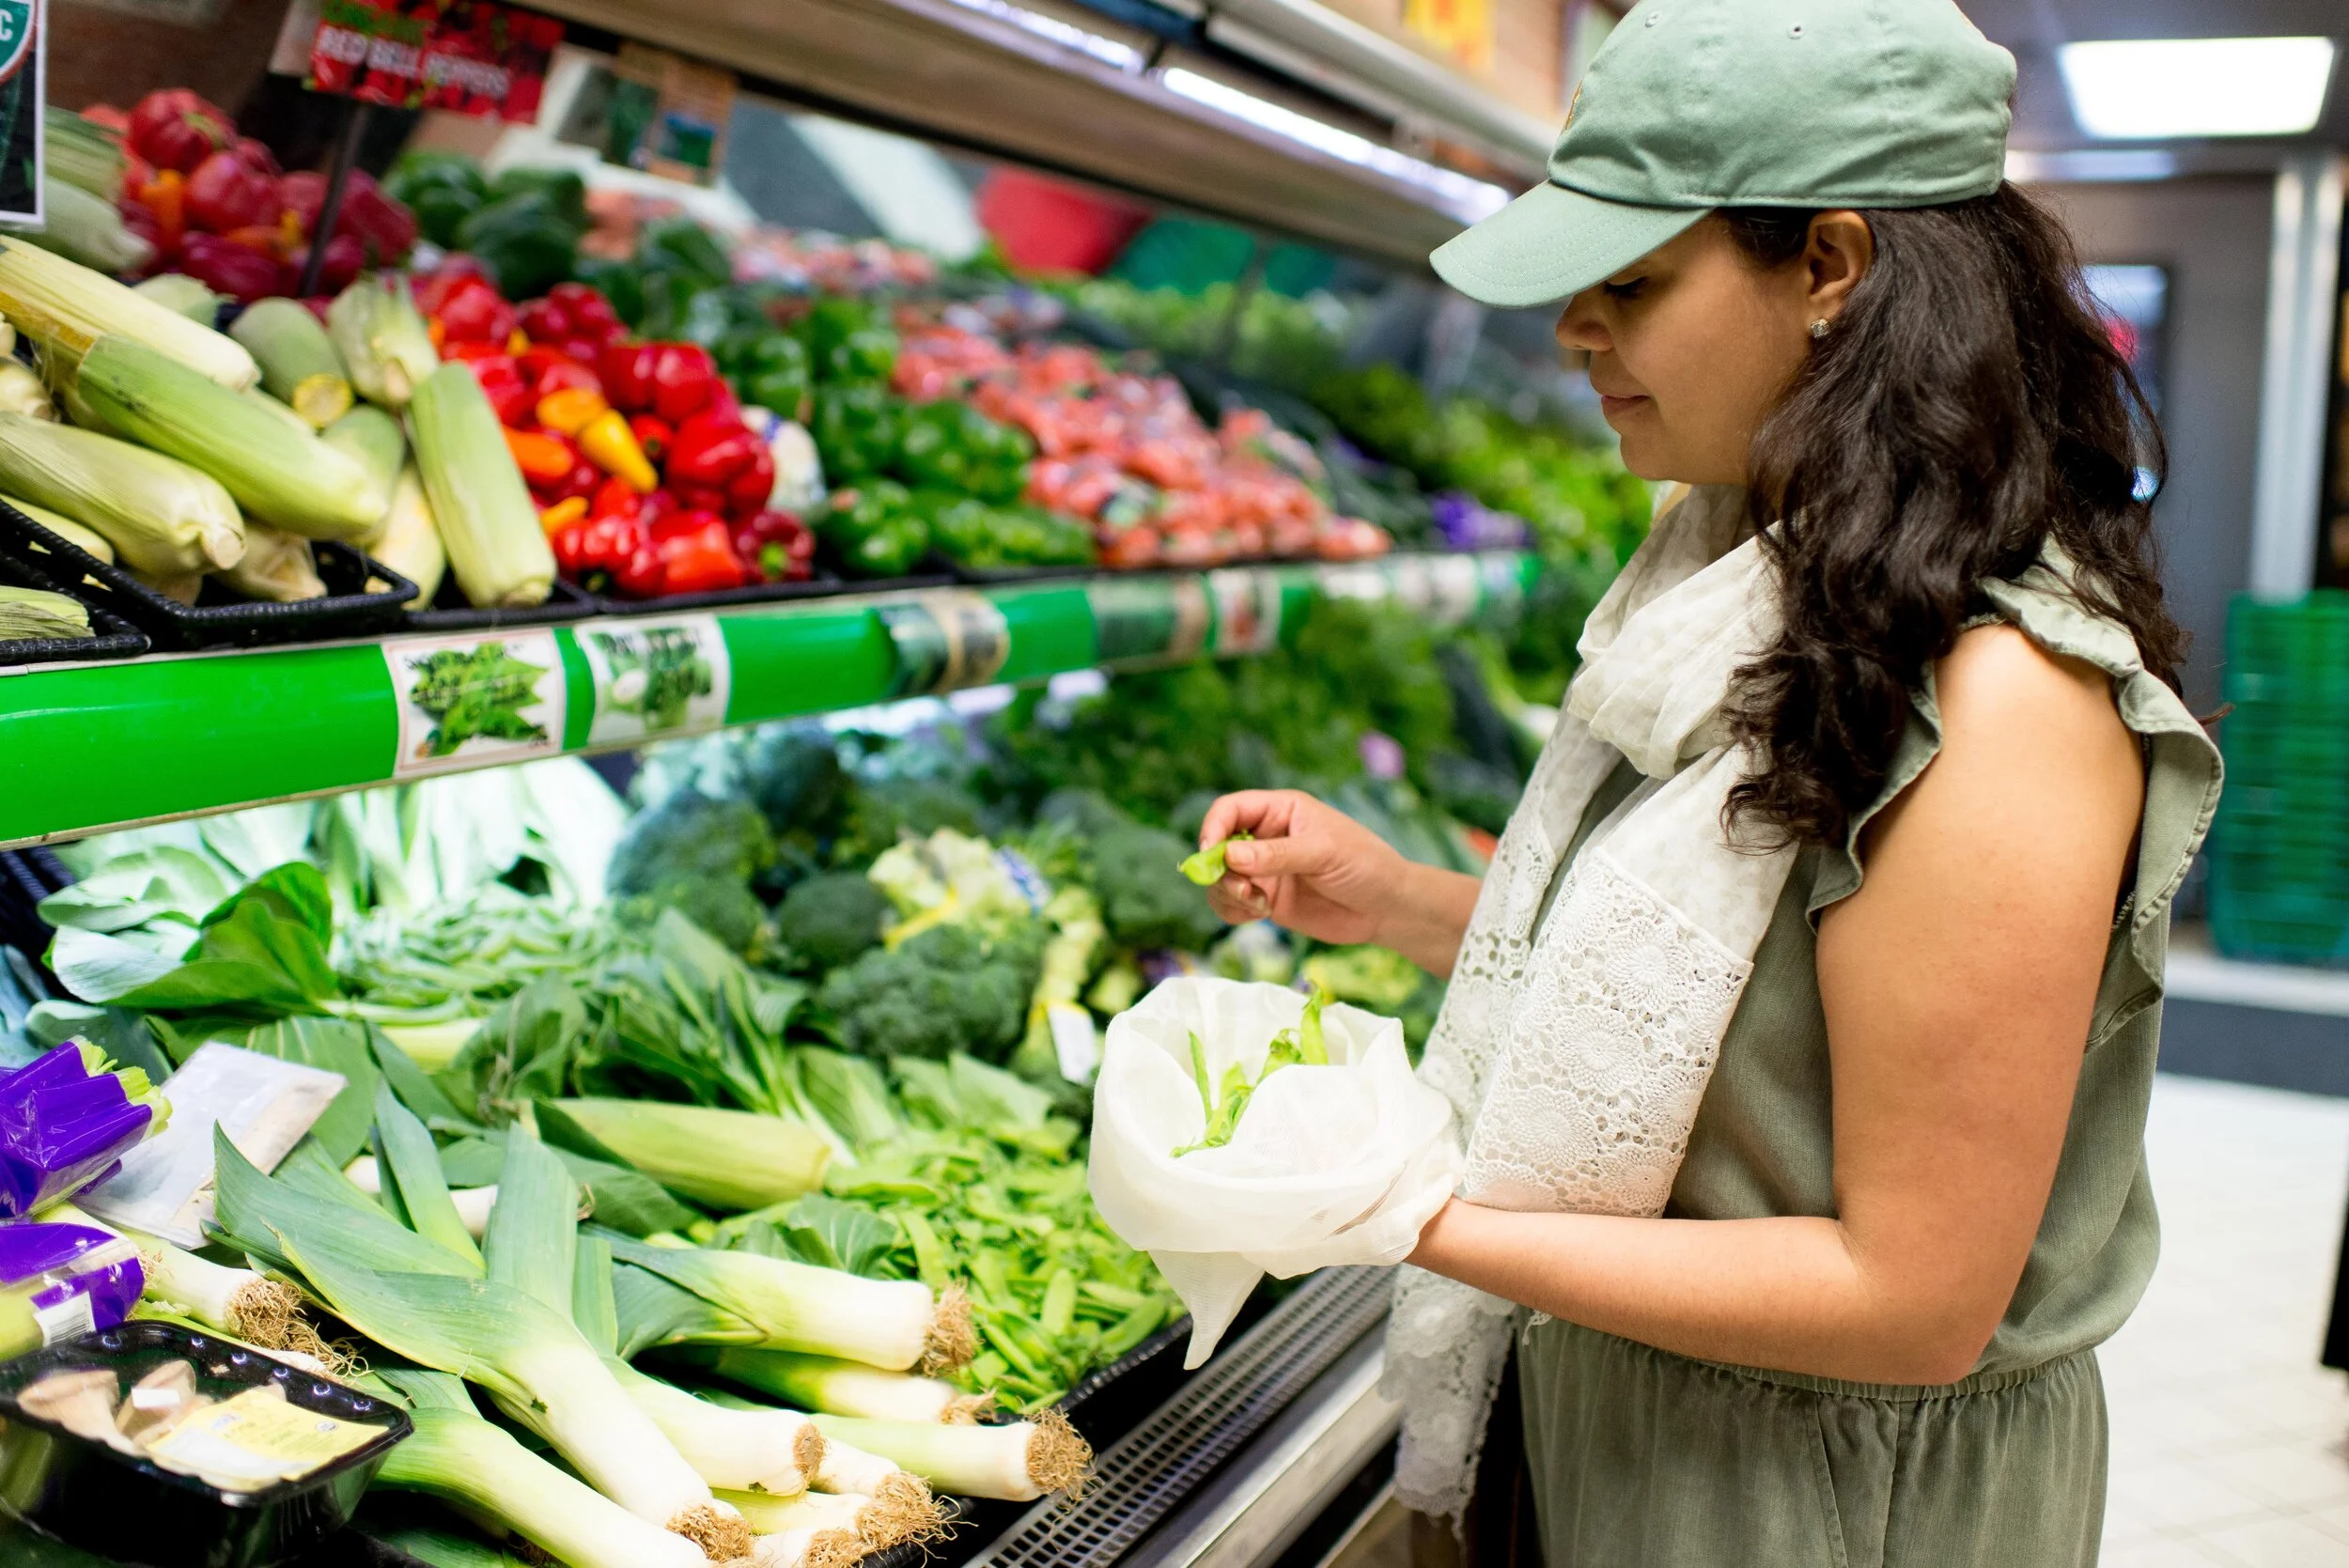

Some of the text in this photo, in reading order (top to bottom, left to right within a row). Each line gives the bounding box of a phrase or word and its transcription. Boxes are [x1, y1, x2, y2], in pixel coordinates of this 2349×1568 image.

[318, 24, 511, 100] RED BELL PEPPERS
